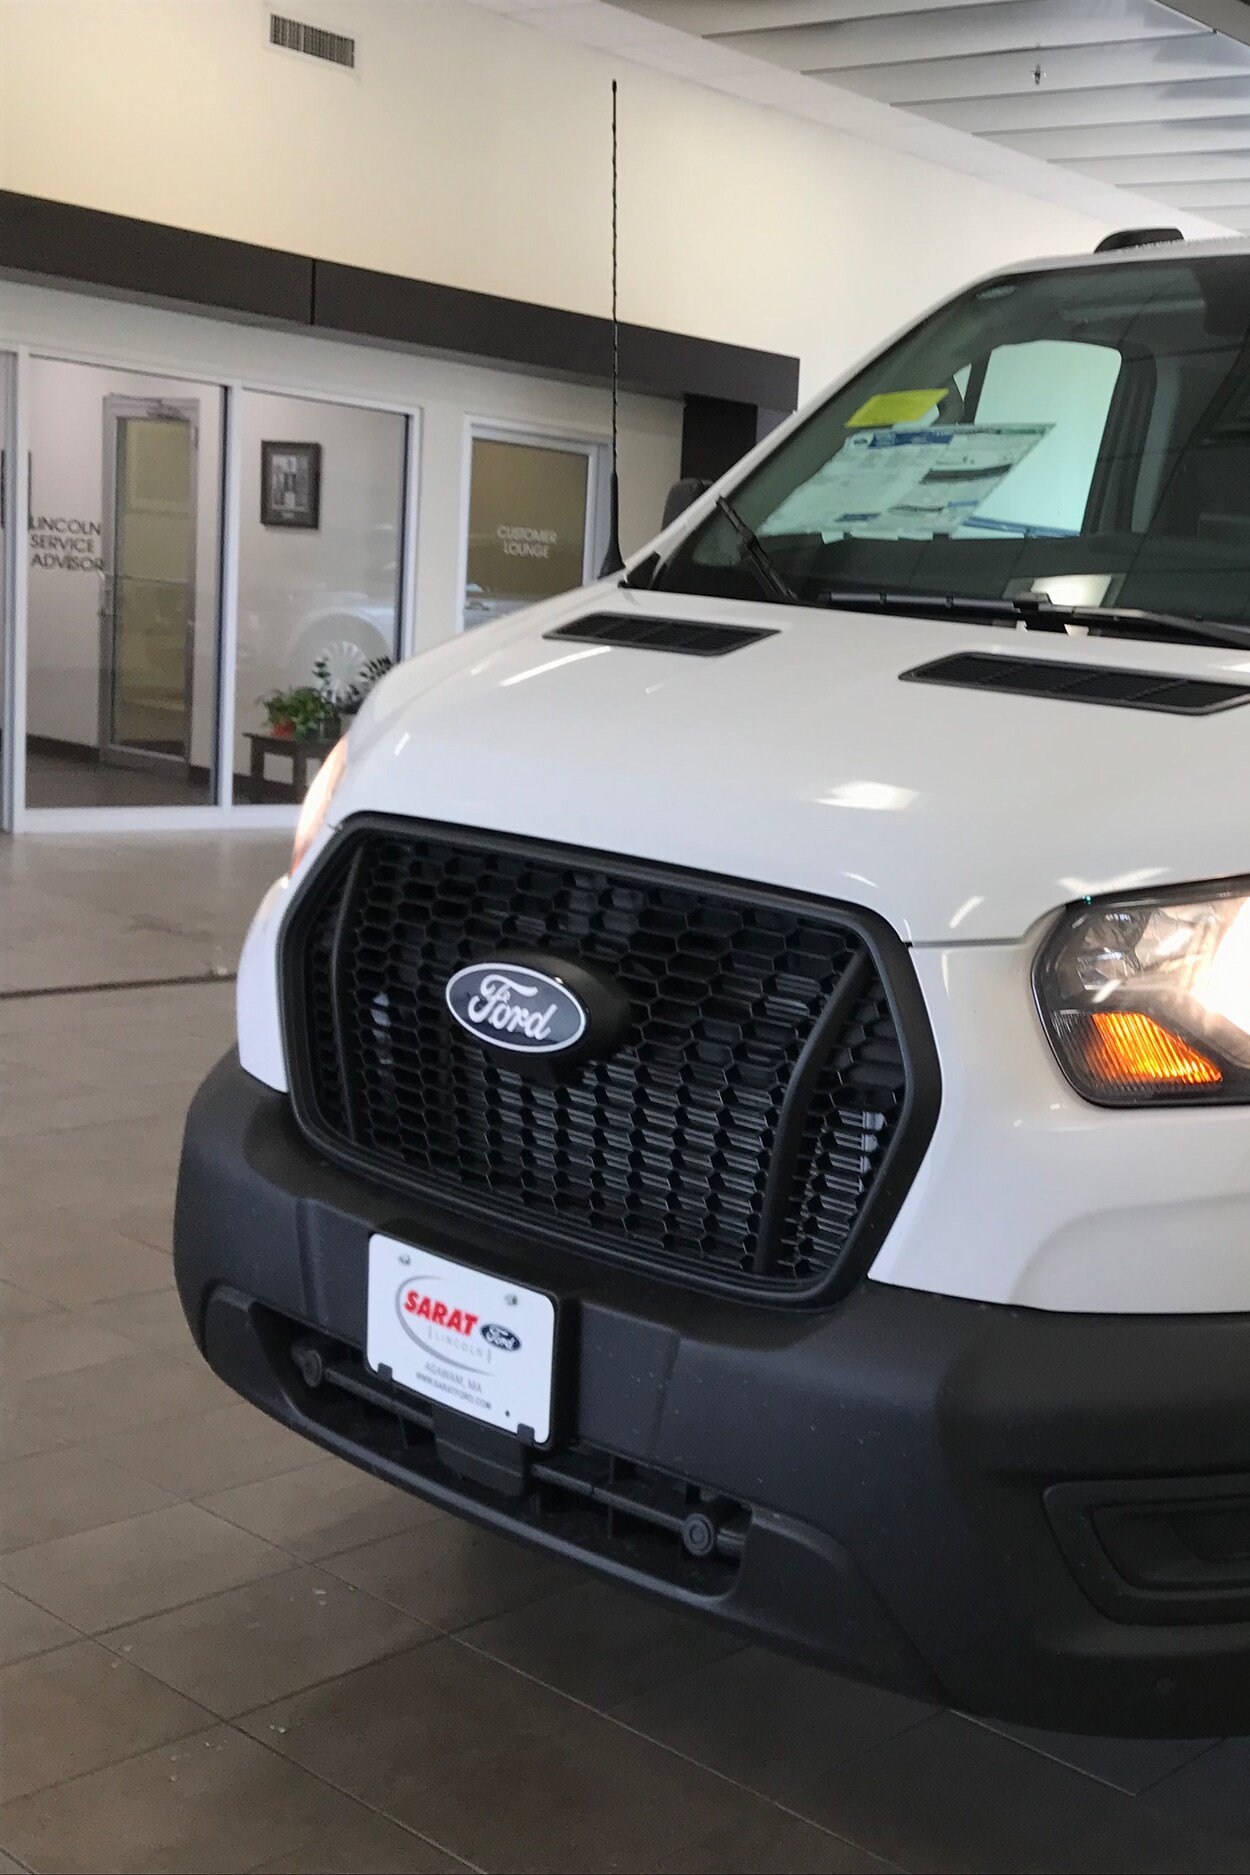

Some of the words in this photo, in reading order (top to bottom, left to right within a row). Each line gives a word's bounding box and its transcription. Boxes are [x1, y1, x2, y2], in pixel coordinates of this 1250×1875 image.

[28, 516, 101, 536] LINCOLN
[497, 525, 558, 545] CUSTOMER
[30, 534, 95, 553] SERVICE
[503, 540, 550, 559] LOUNGE
[31, 553, 105, 572] ADVISOR
[467, 973, 559, 1041] Ford
[404, 1289, 479, 1337] SARAT
[434, 1330, 484, 1358] LINCOLN
[485, 1325, 516, 1351] Ford
